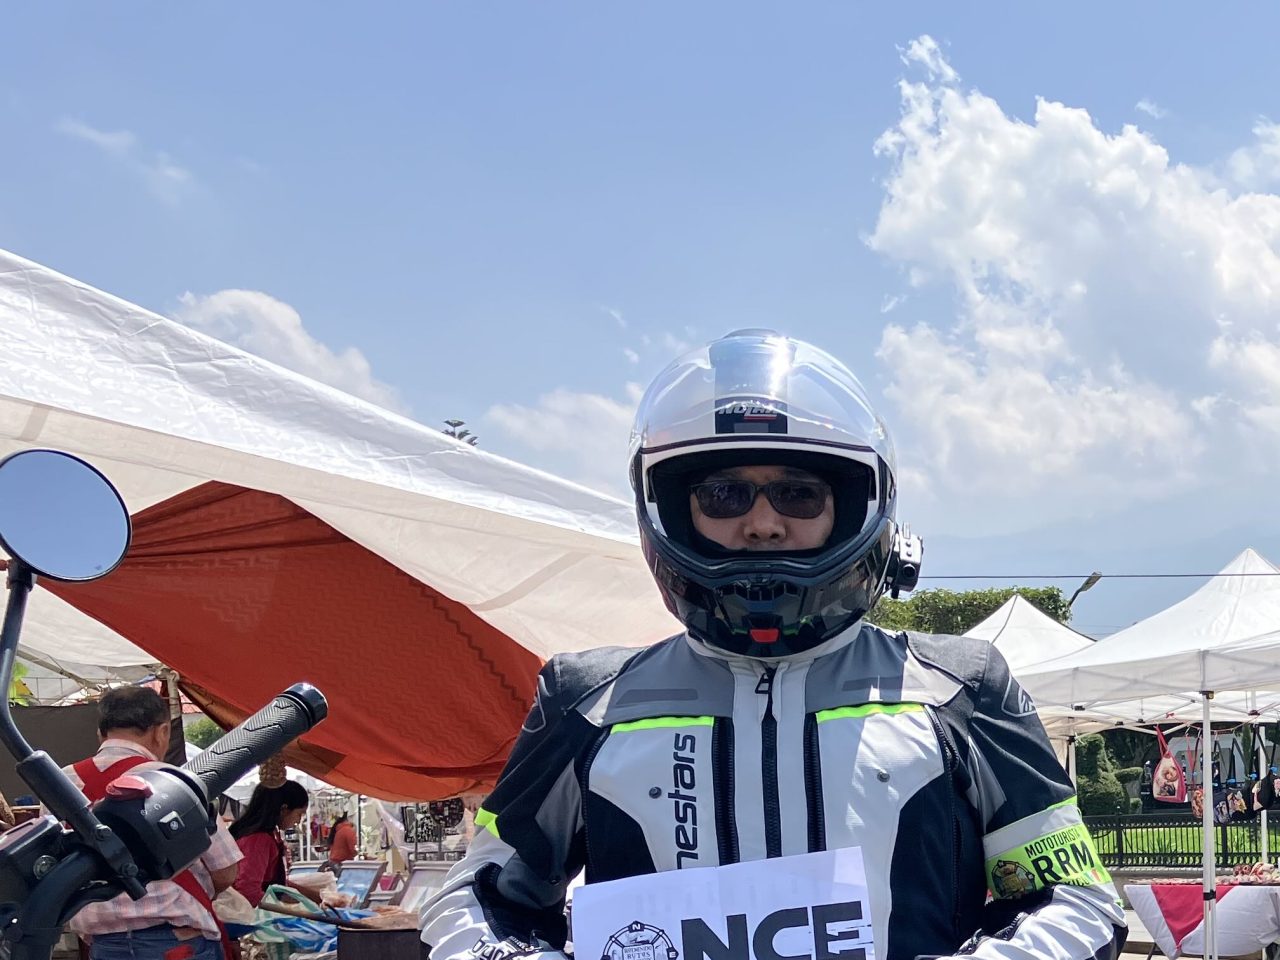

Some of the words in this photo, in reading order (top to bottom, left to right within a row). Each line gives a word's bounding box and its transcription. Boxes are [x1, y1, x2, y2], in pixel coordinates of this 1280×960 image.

[668, 732, 699, 869] nestars
[1024, 828, 1081, 859] MOTOTURISTA
[1031, 840, 1095, 887] RRM
